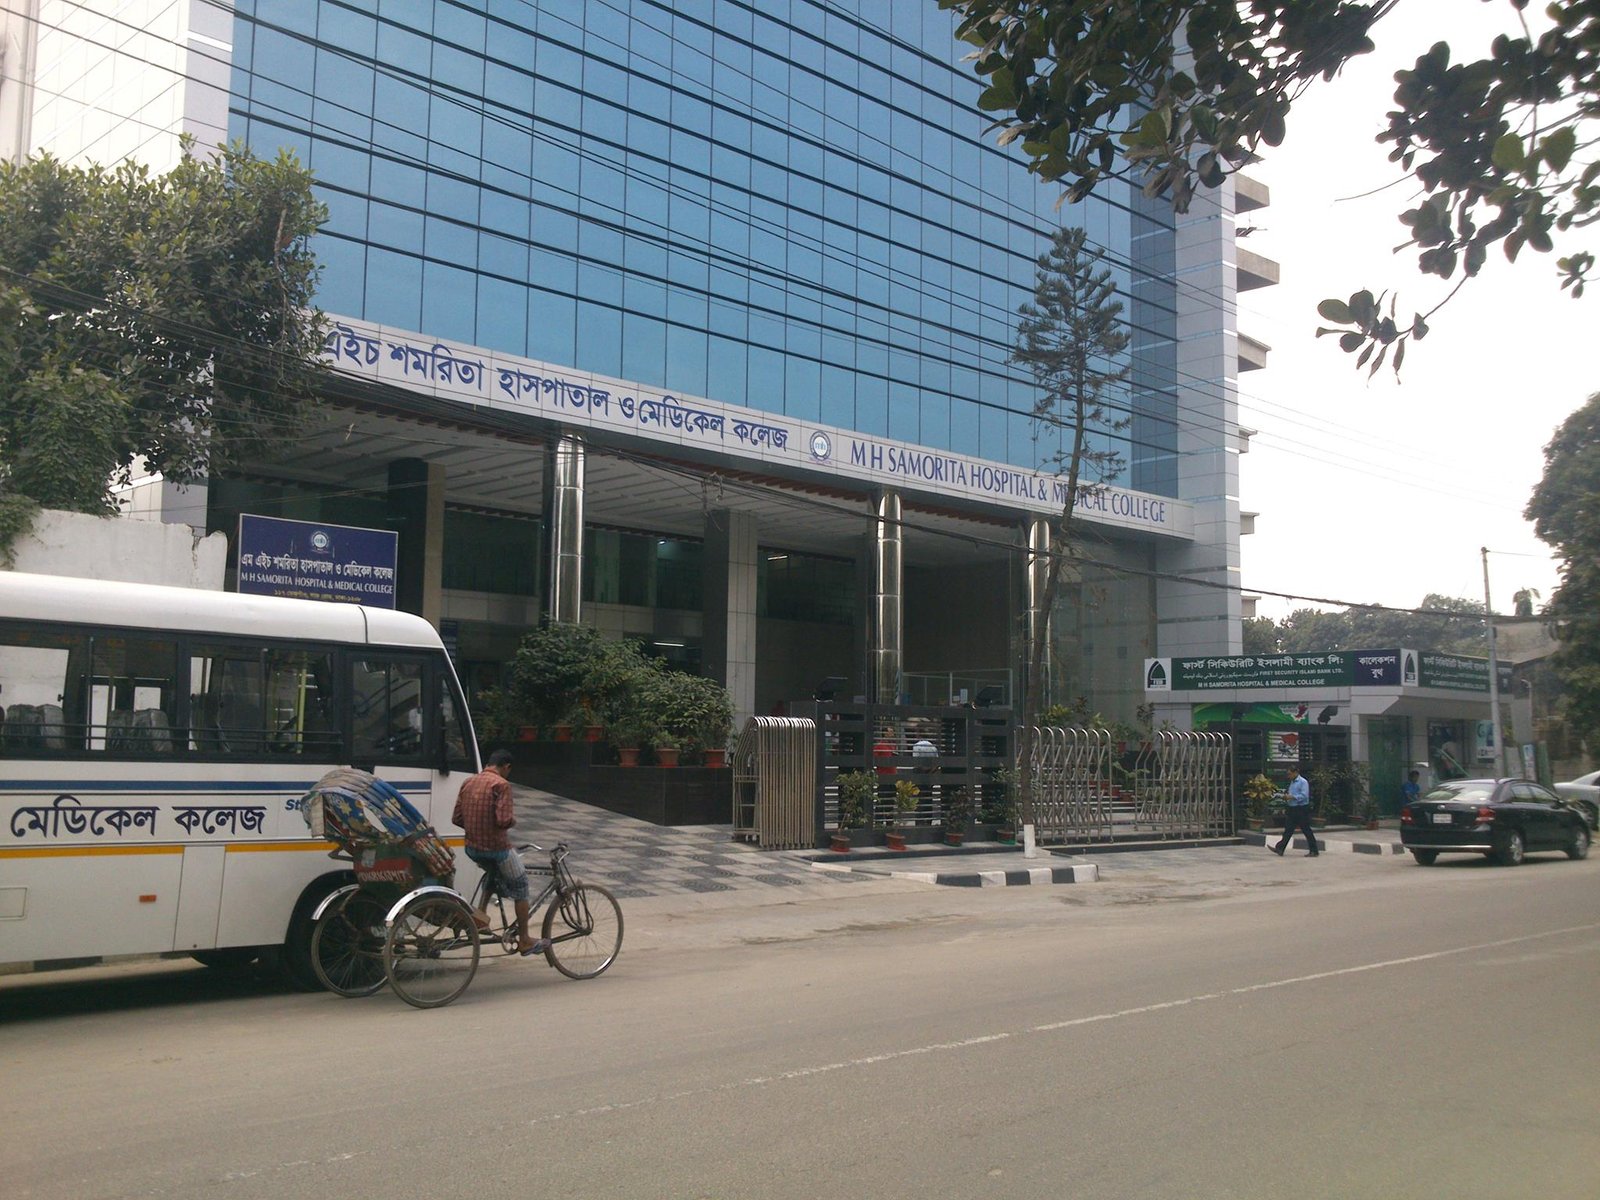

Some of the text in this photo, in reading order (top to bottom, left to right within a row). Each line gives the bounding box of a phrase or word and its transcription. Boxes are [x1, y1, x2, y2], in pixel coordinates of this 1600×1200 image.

[324, 321, 788, 453] এইচ শমরিতা হাসপাতাল ও মেডিকেল কলেজ
[851, 440, 866, 466] M
[871, 444, 883, 470] H
[888, 447, 967, 485] SAMORITA
[971, 464, 1036, 499] HOSPITAL
[1037, 478, 1048, 502] &
[1112, 493, 1166, 523] COLLEGE
[241, 550, 394, 581] এম এইচ শমরিতা হাসপাতাল ও মেডিকেল কলেজ
[241, 572, 393, 594] M H SAMORITA HOSPITAL & MEDICAL COLLEGE
[1206, 657, 1254, 669] সিকিউরিটি
[1257, 656, 1293, 669] ইসলামী
[1297, 656, 1324, 666] ব্যাংক
[1297, 678, 1325, 686] COLLEGE
[11, 793, 267, 838] মেডিকেল কলেজ
